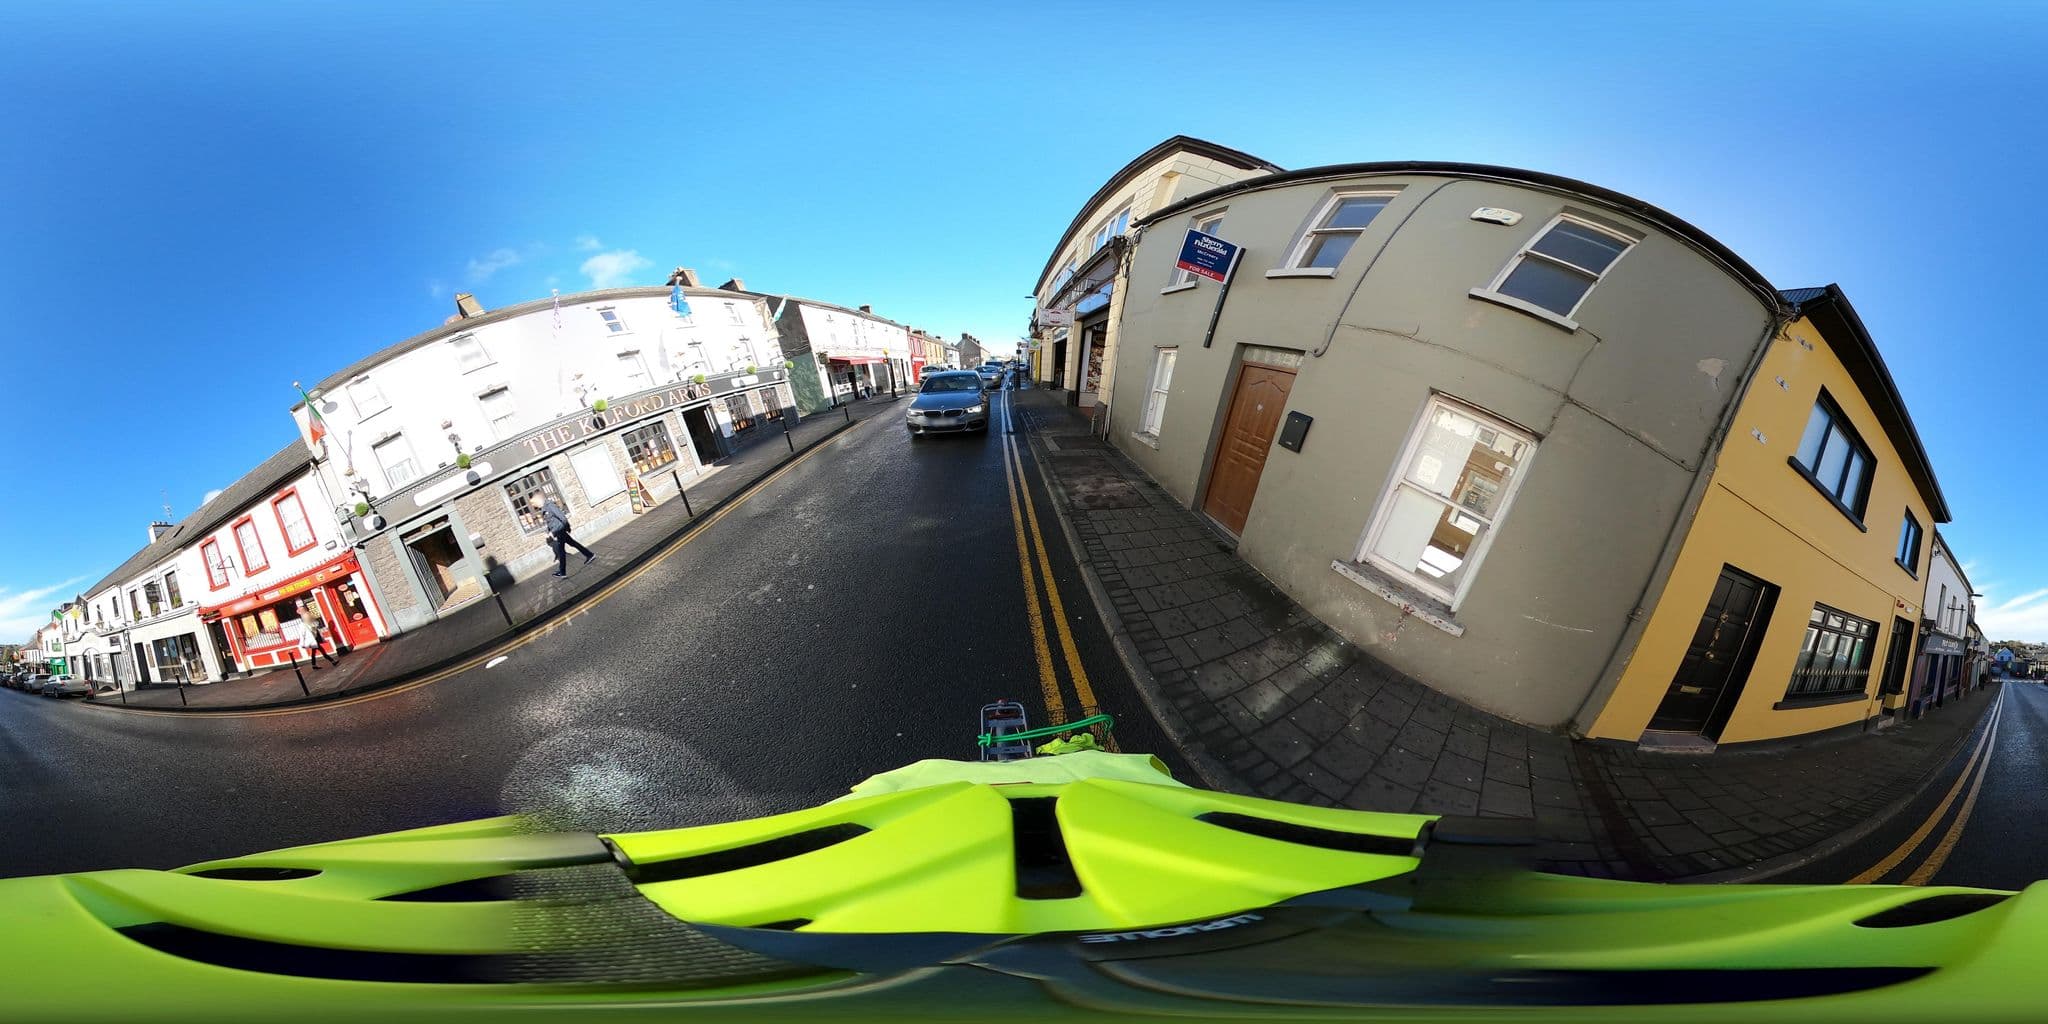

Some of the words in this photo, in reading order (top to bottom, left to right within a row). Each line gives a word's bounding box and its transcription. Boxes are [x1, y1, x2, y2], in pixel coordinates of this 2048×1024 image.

[523, 425, 575, 456] THE
[577, 394, 664, 435] KILFORD
[668, 383, 711, 405] ARMS
